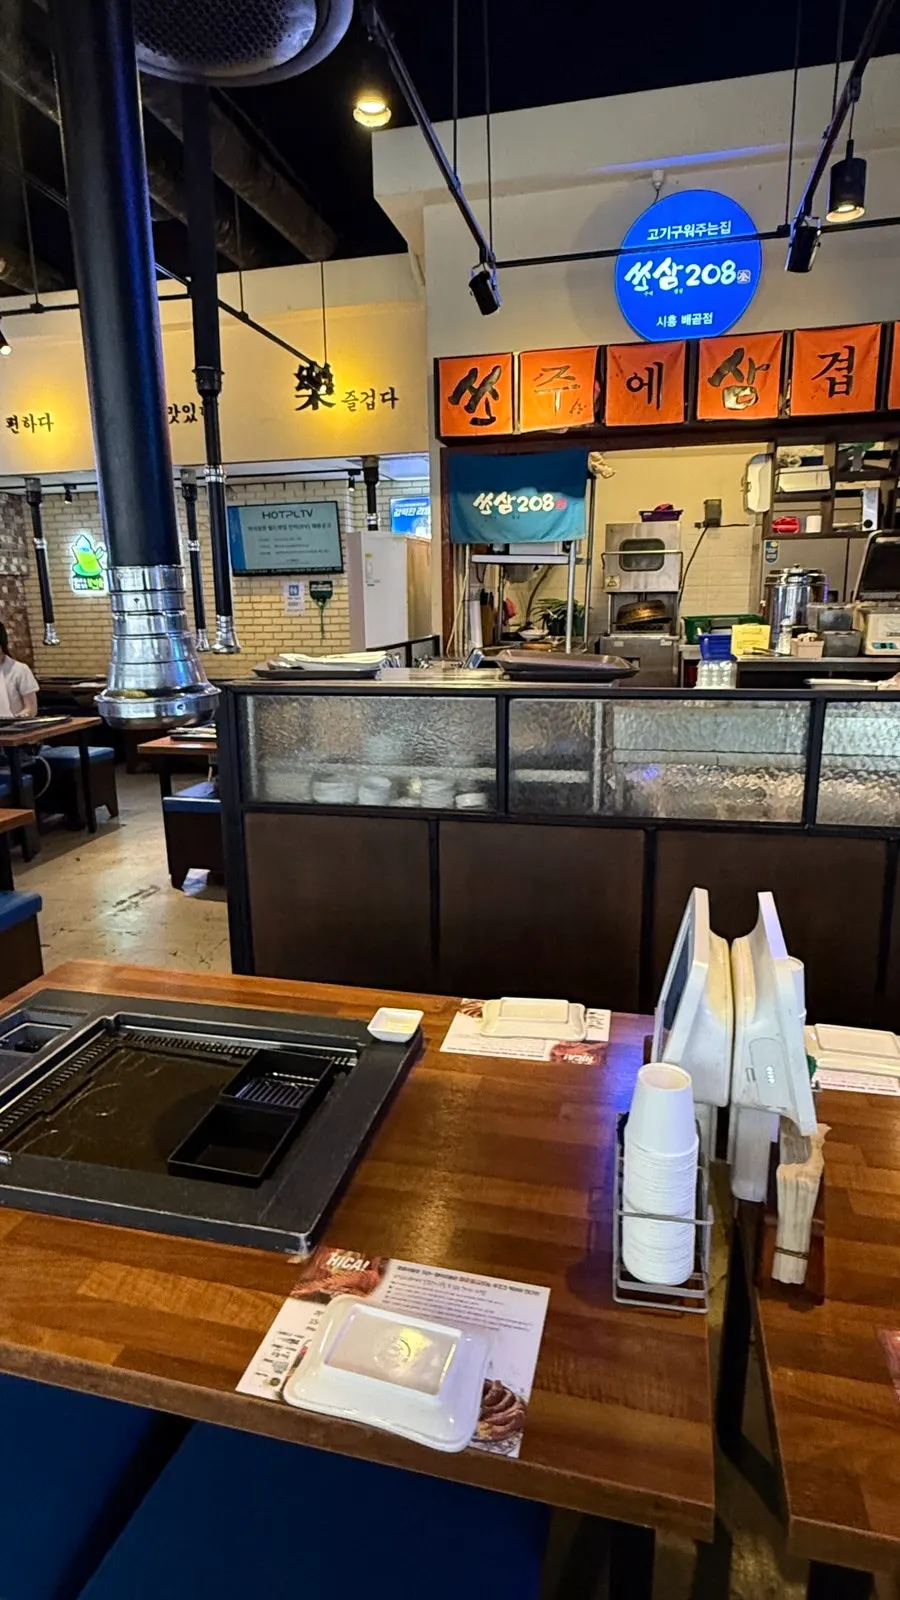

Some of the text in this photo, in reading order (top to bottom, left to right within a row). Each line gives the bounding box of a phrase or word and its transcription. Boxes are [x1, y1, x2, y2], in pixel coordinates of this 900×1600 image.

[647, 220, 732, 240] 고기구워주는집
[656, 315, 677, 328] 시흥
[341, 387, 400, 413] 즐겁다
[5, 412, 55, 435] 편하다
[167, 401, 205, 425] 맛있
